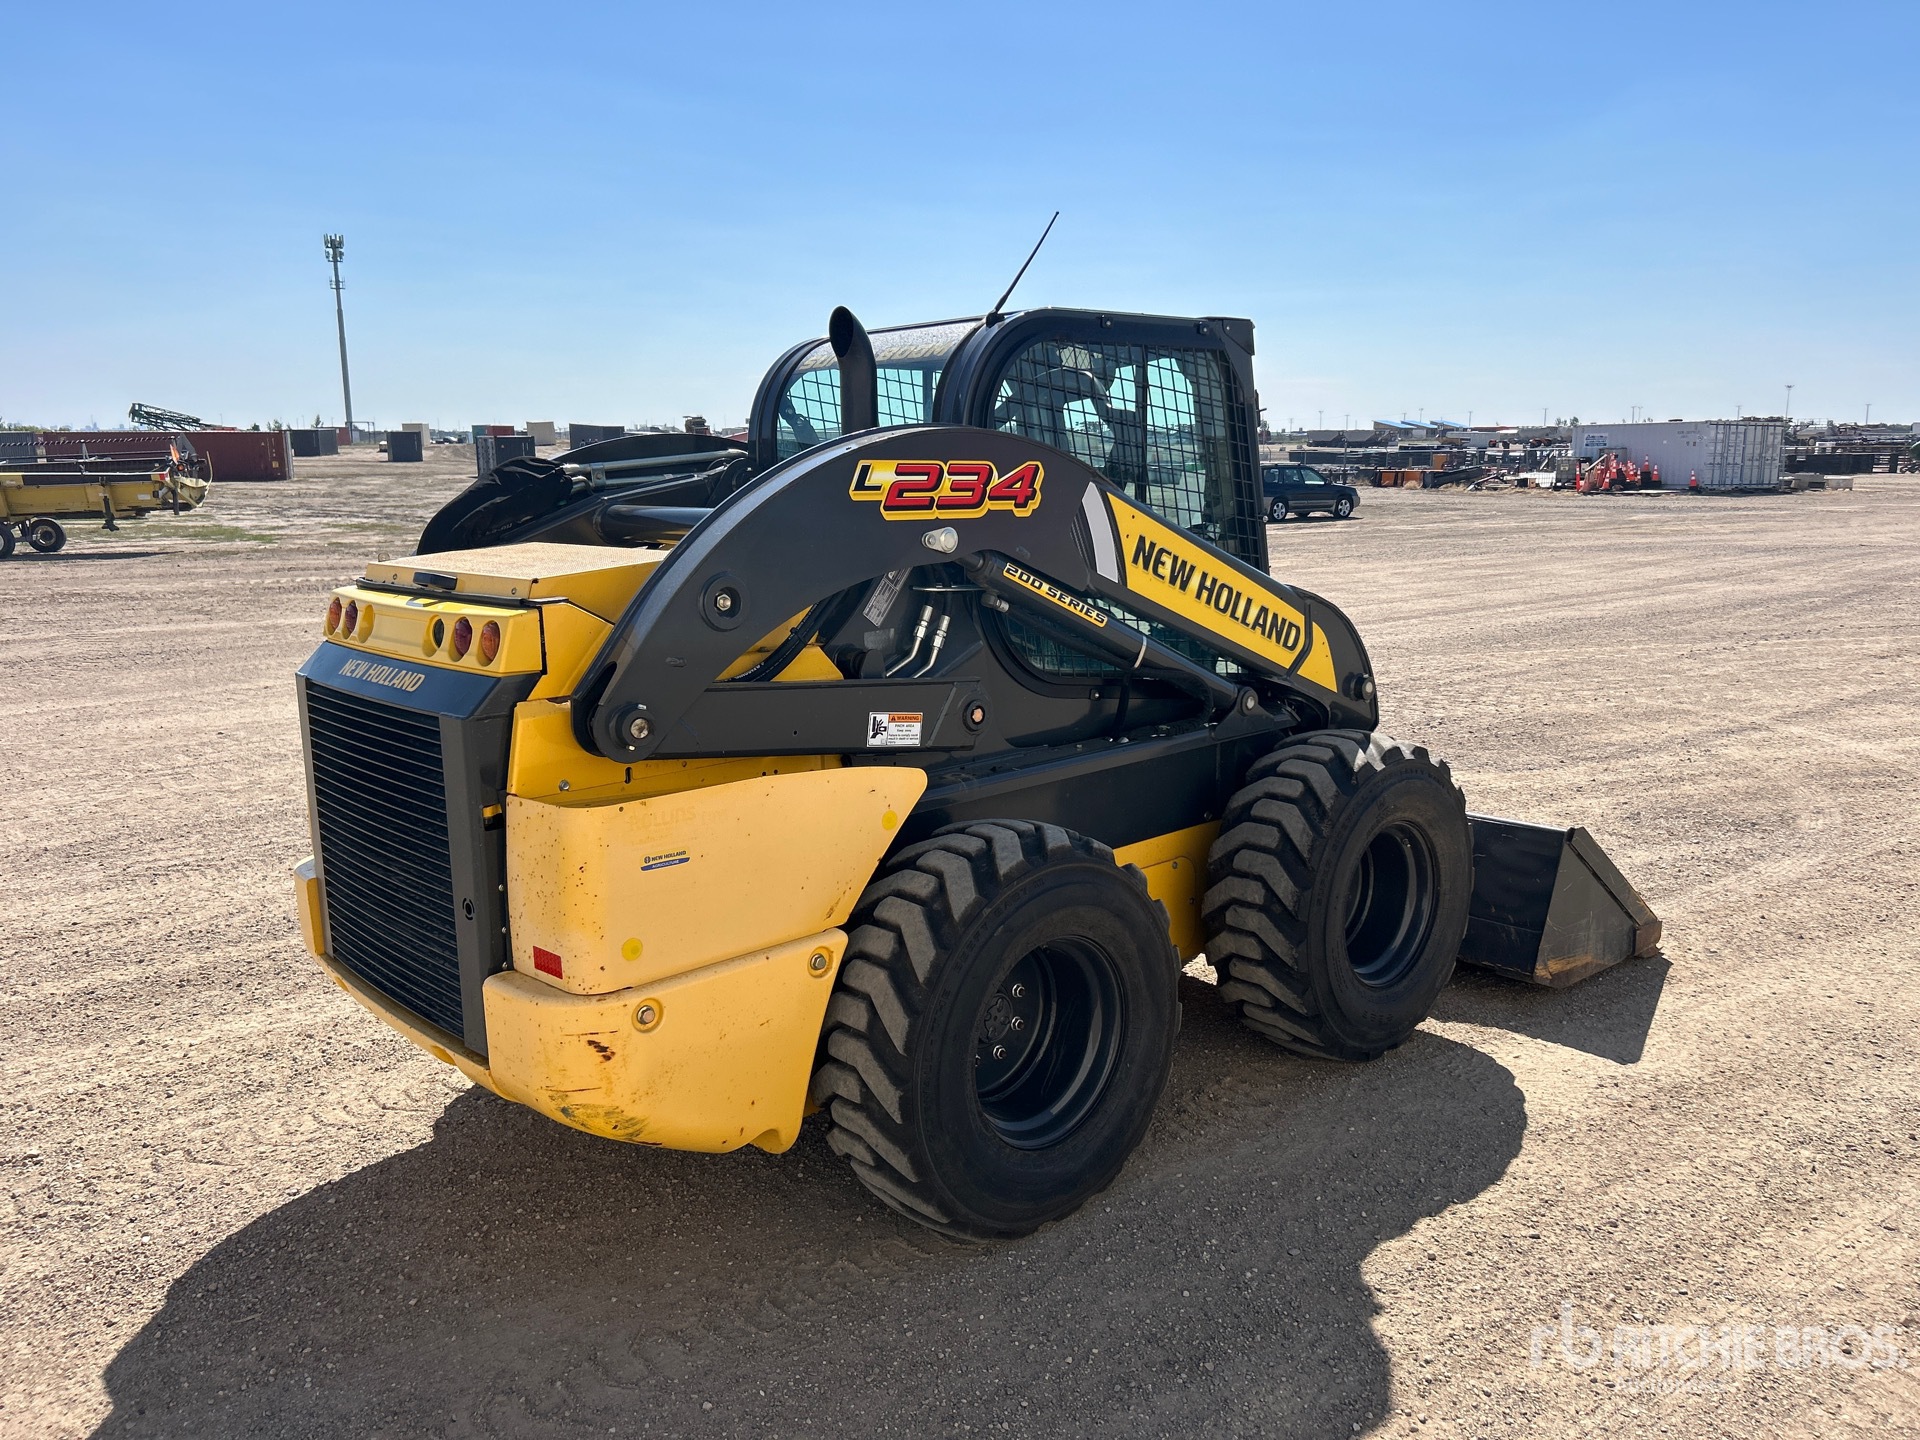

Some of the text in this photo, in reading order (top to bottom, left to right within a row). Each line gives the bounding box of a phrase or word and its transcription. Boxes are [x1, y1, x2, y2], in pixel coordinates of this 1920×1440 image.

[850, 460, 1042, 518] L234
[1005, 567, 1107, 624] 200 SERIES
[1131, 534, 1302, 652] NEW HOLLAND
[338, 659, 426, 691] NEW HOLLAND
[651, 850, 687, 862] NEW HOLLAND
[651, 860, 680, 868] AGRICULTURE
